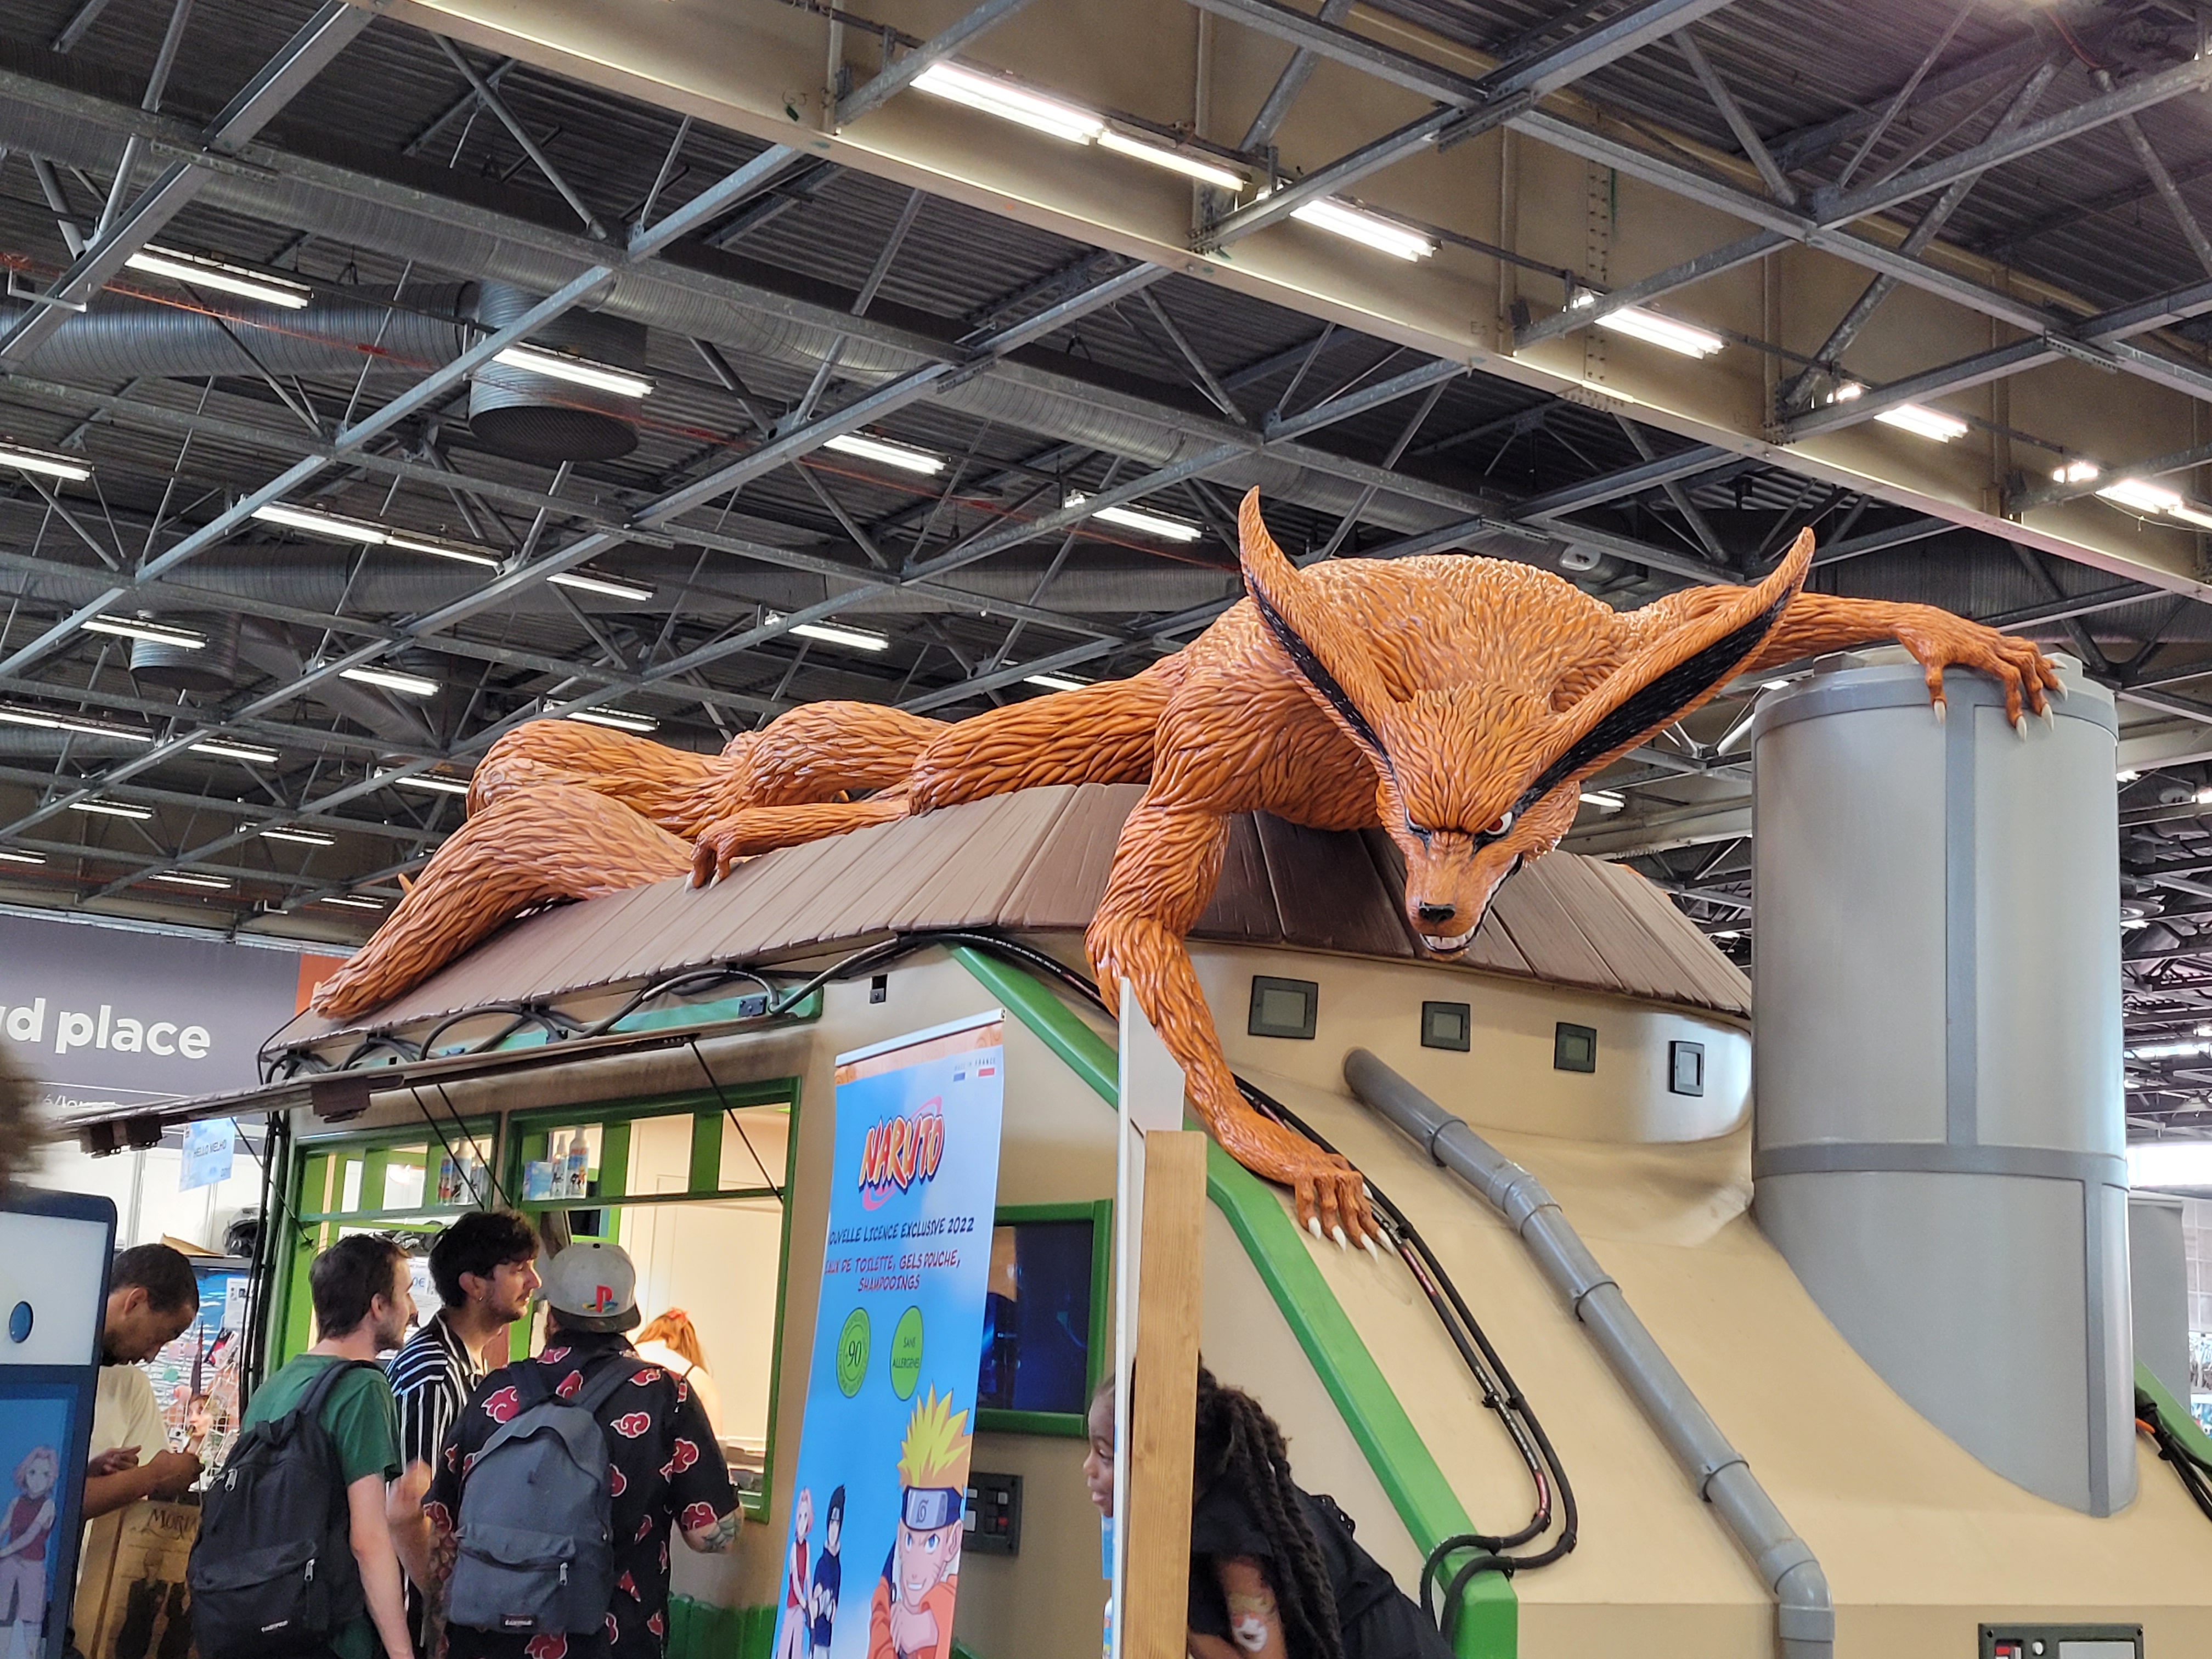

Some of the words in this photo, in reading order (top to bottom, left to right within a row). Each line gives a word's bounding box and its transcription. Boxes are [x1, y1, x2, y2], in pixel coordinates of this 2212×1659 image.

[55, 1005, 211, 1059] place
[858, 1113, 945, 1195] NARUTO
[828, 1227, 862, 1245] OUVELLE
[863, 1223, 899, 1242] LICENCE
[900, 1217, 946, 1238] EXCLUSIVE
[947, 1216, 974, 1234] 2022
[841, 1257, 852, 1273] DE
[855, 1254, 896, 1273] TOILETTE,
[899, 1253, 922, 1270] GELS
[857, 1274, 920, 1293] SHAMPOOINGS
